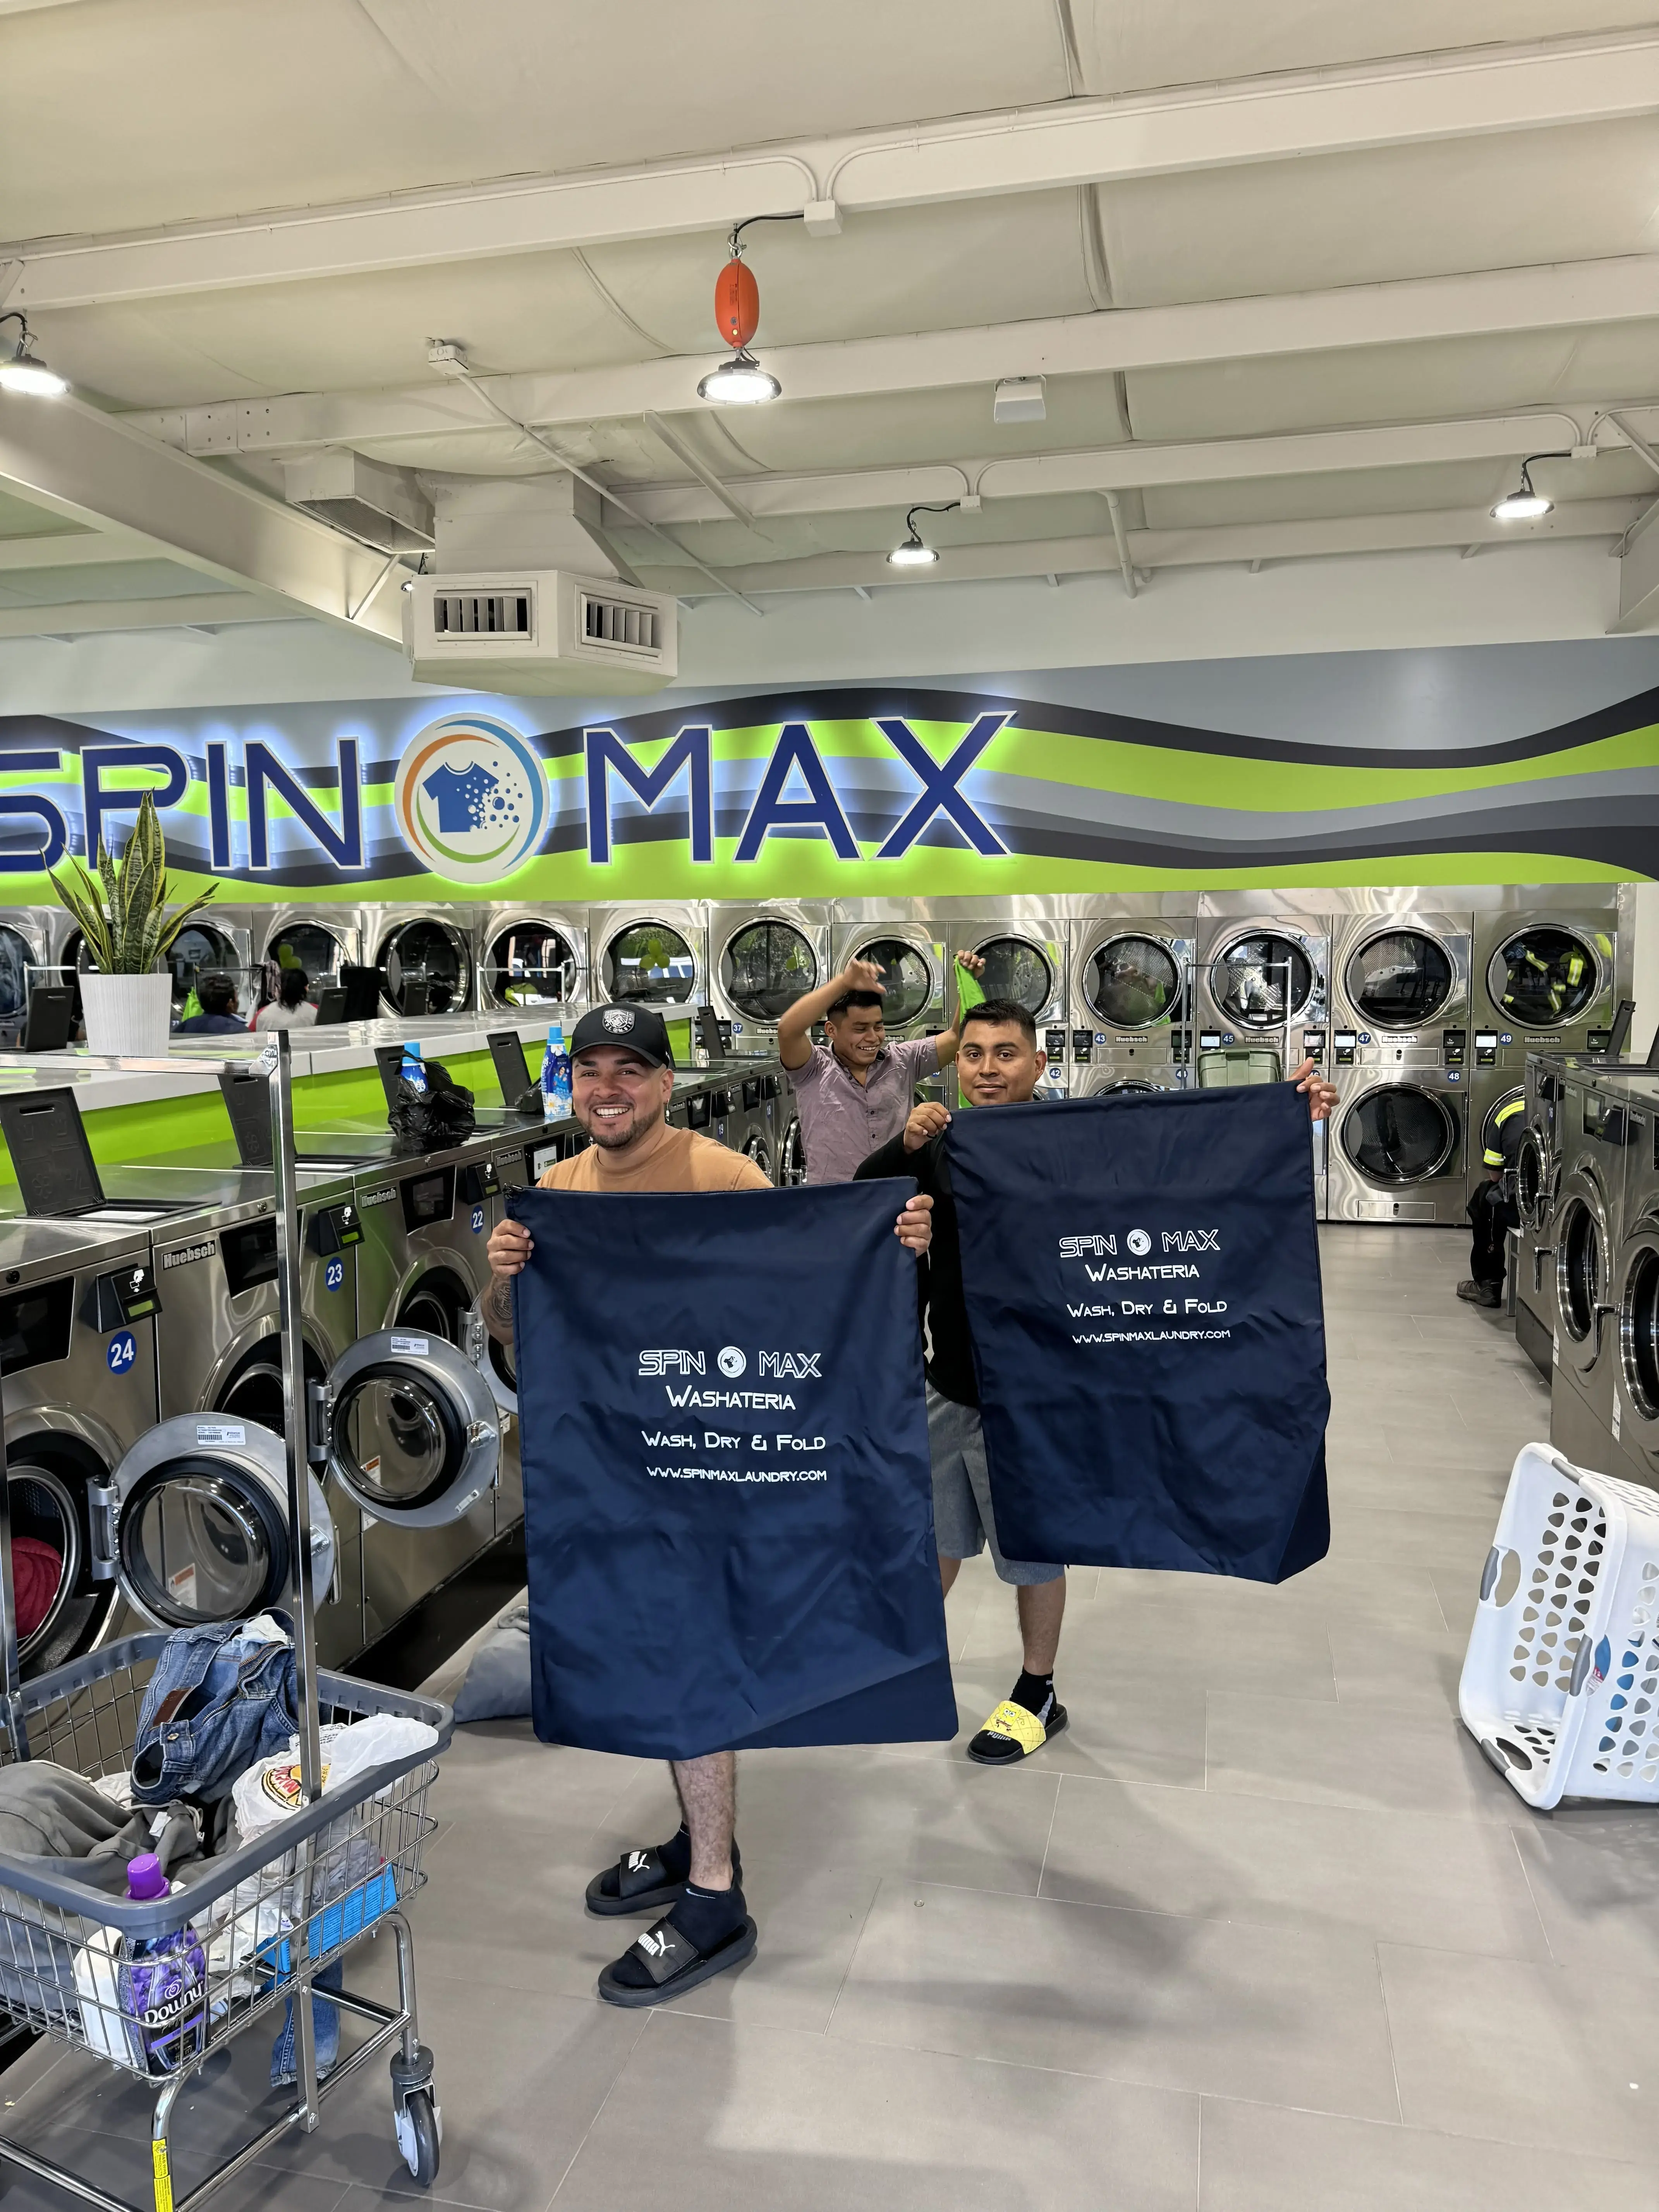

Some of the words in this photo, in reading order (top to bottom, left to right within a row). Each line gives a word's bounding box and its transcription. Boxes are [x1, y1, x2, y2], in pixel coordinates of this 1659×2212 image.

[0, 736, 366, 874] SPIN
[583, 711, 1017, 866] MAX
[719, 1123, 723, 1135] 19
[362, 1188, 396, 1207] Huebsch
[473, 1211, 483, 1228] 22
[163, 1242, 215, 1268] Huebsch
[1059, 1235, 1117, 1258] SPIN
[1162, 1229, 1220, 1252] MAX
[328, 1264, 342, 1285] 23
[1163, 1300, 1177, 1314] &
[111, 1339, 134, 1367] 24
[639, 1350, 706, 1376] SPIN
[759, 1351, 822, 1378] MAX
[751, 1435, 767, 1451] &
[144, 1984, 203, 2023] Downy
